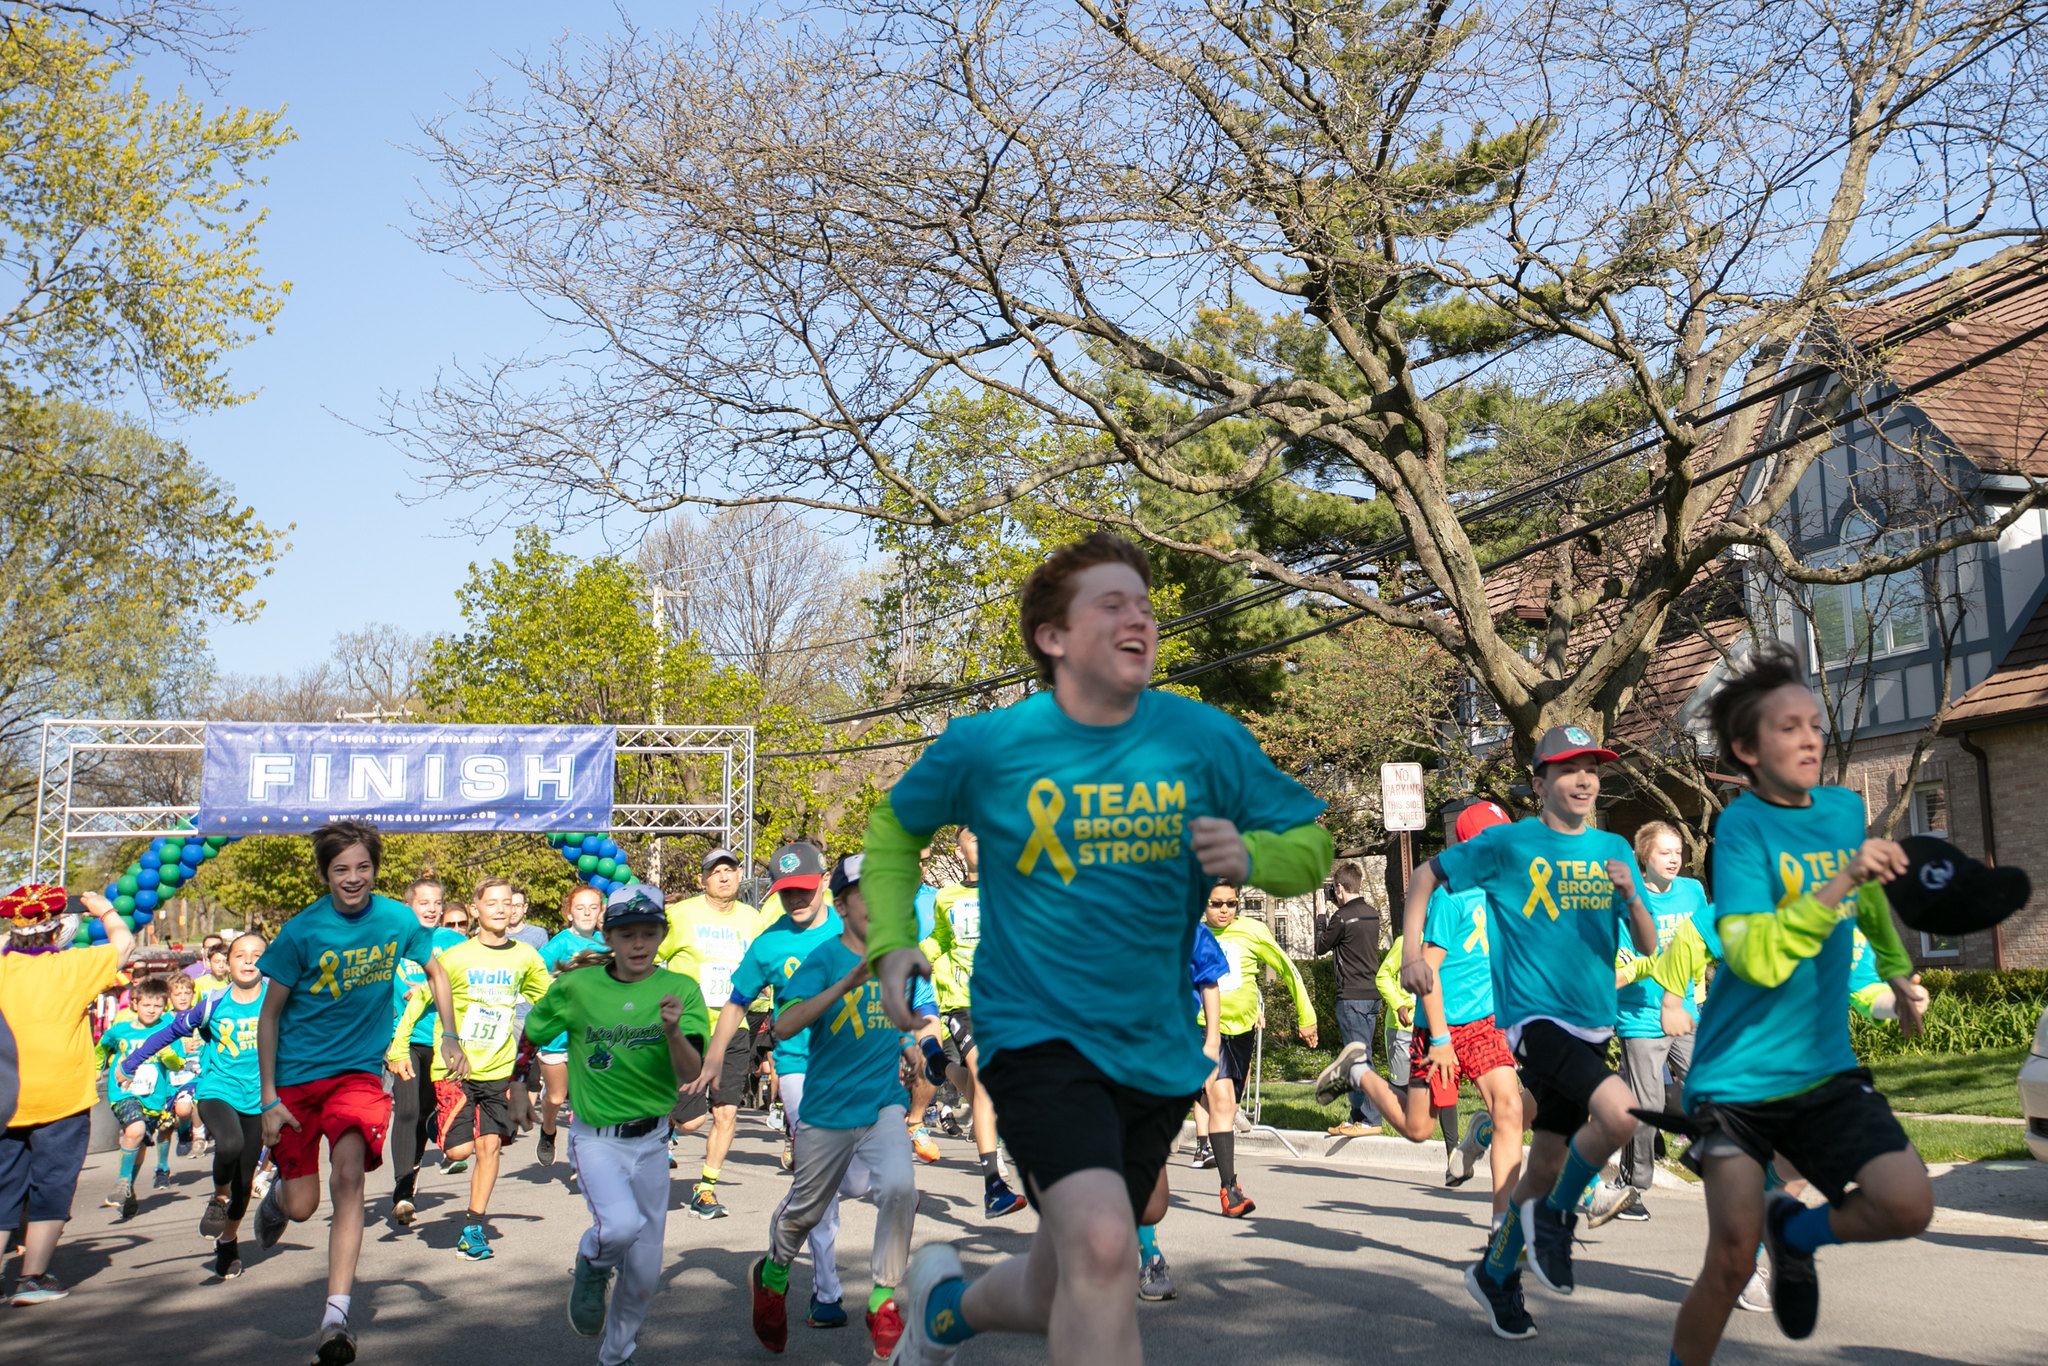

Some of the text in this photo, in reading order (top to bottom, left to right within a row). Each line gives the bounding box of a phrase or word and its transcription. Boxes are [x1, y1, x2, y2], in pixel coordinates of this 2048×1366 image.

[330, 734, 504, 744] SPECIAL EVENTS MANAGEMENT
[248, 753, 575, 801] FINISH
[1395, 769, 1409, 782] NO
[1072, 780, 1186, 817] TEAM
[1385, 783, 1422, 797] PARKING
[1388, 800, 1422, 810] THIS SIDE
[1399, 811, 1422, 821] STREET
[1073, 813, 1183, 840] BROOKS
[1078, 838, 1181, 865] STRONG
[1556, 861, 1611, 880] TEA
[1802, 848, 1857, 880] TEA
[343, 942, 397, 967] TEAM
[343, 958, 394, 980] BROOKS
[344, 970, 392, 991] STRONG
[710, 979, 732, 995] 230
[471, 1022, 497, 1040] 151
